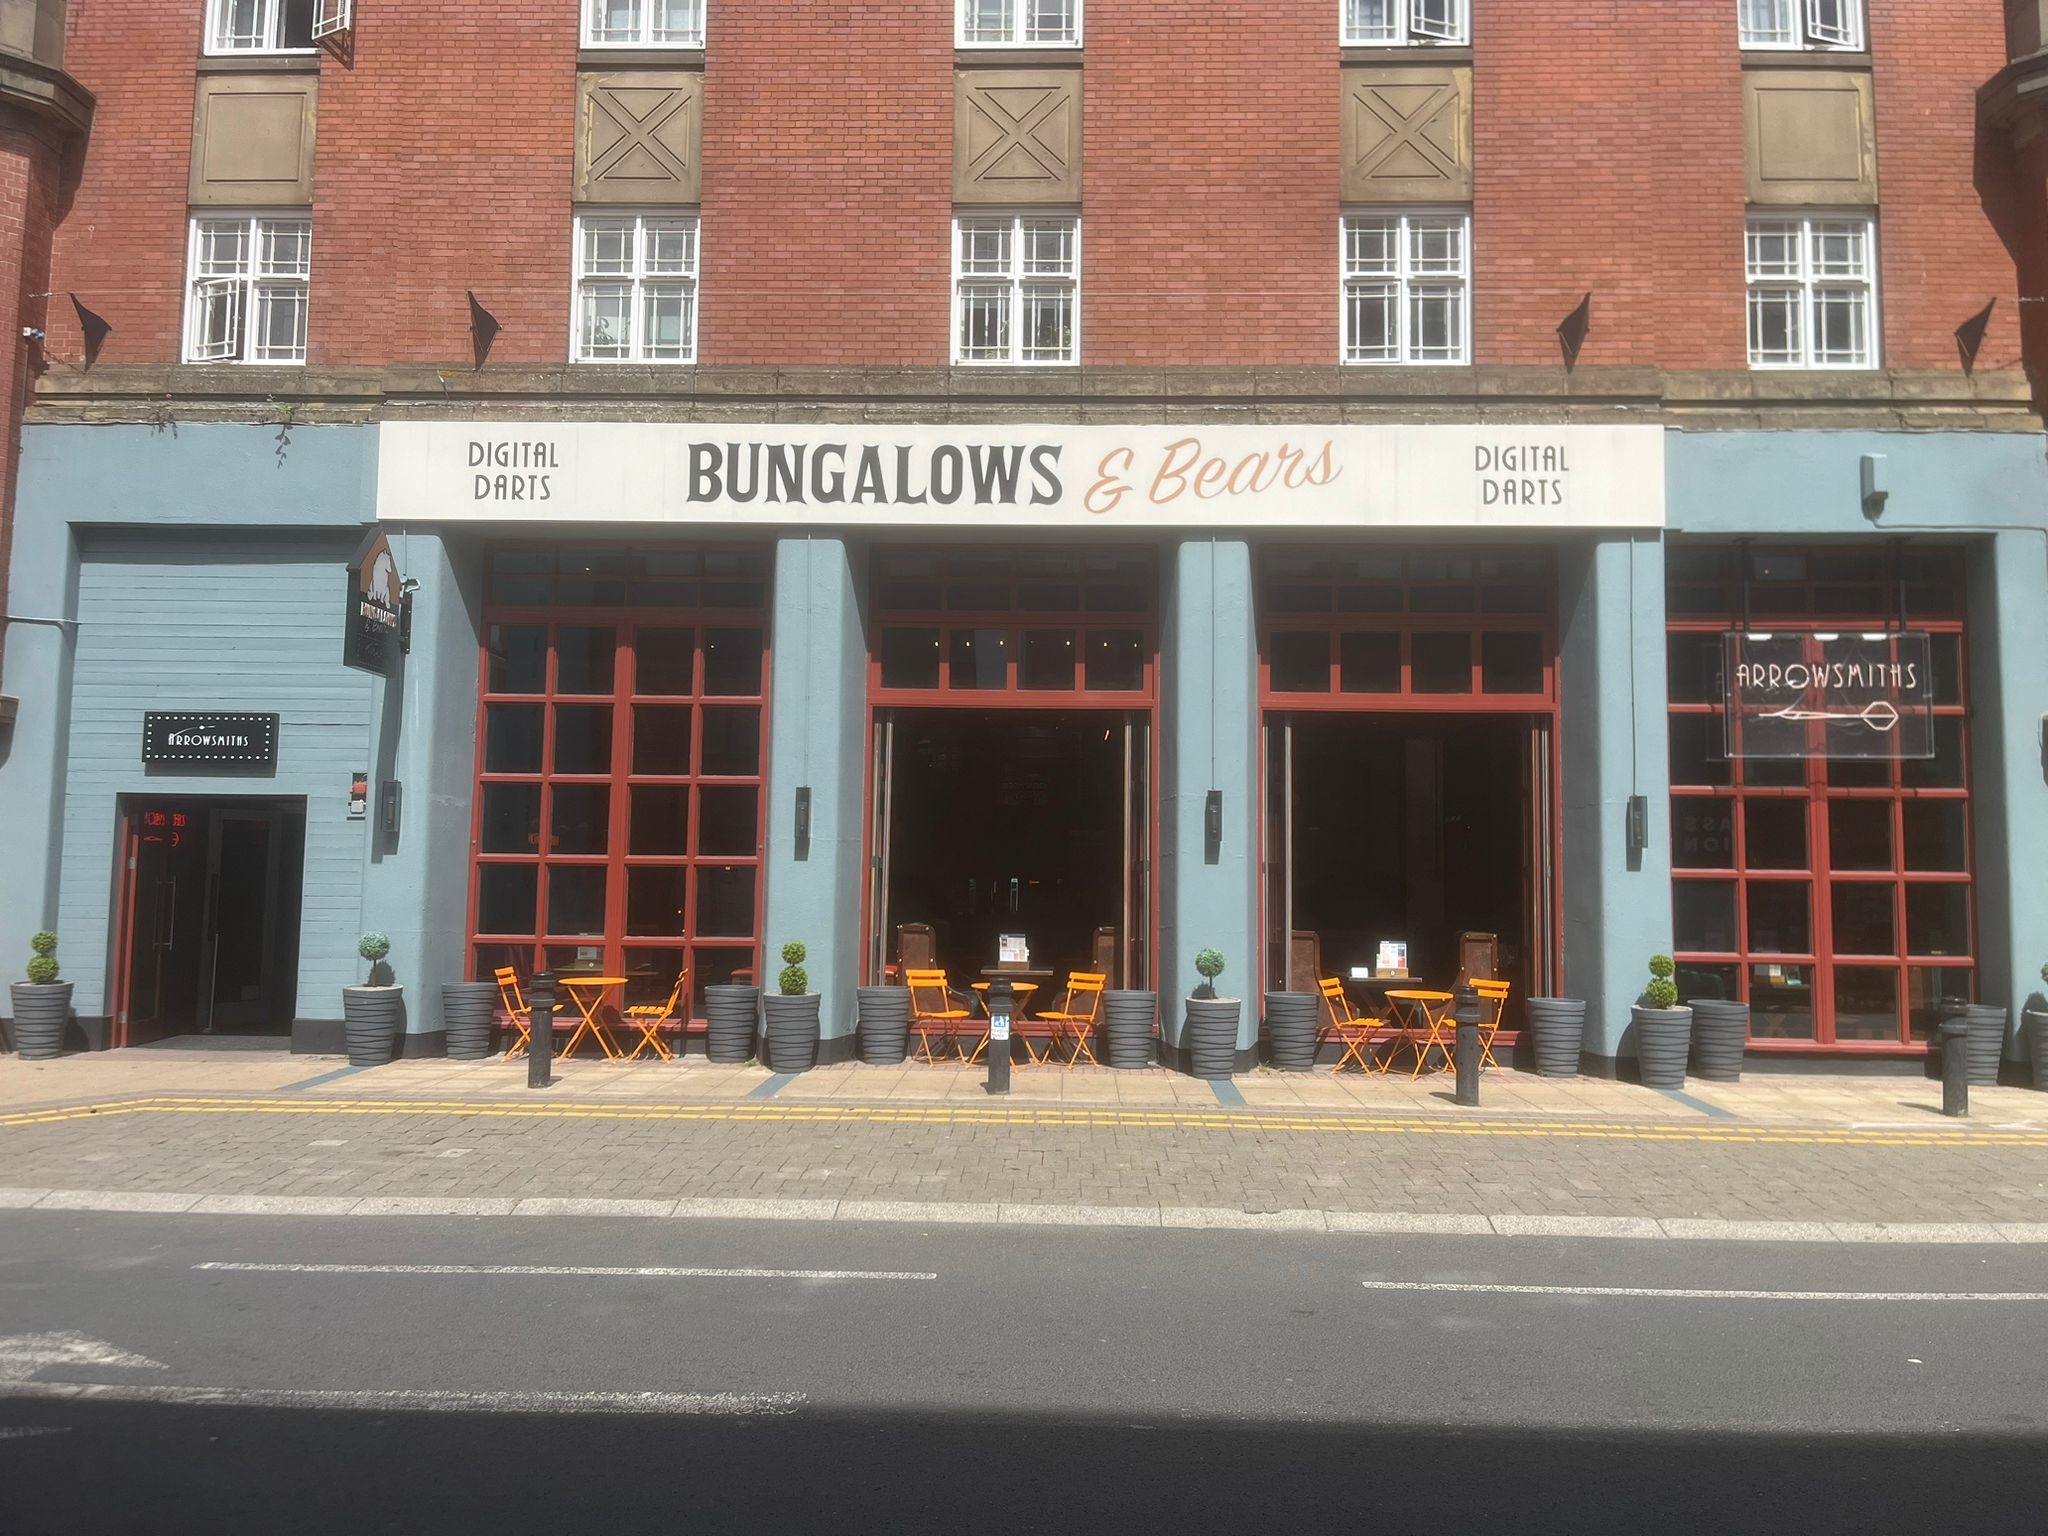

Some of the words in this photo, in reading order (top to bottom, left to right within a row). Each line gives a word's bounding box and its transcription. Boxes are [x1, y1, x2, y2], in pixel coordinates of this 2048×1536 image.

[468, 441, 560, 468] DIGITAL
[1474, 445, 1571, 472] DIGITAL
[474, 474, 551, 501] DARTS
[687, 441, 1064, 506] BUNGALOWS
[1082, 446, 1136, 514] &
[1148, 436, 1343, 506] Bears
[1482, 478, 1563, 505] DARTS
[1736, 662, 1918, 689] ARROWSMITHS
[168, 733, 249, 747] ARROWSMITHS
